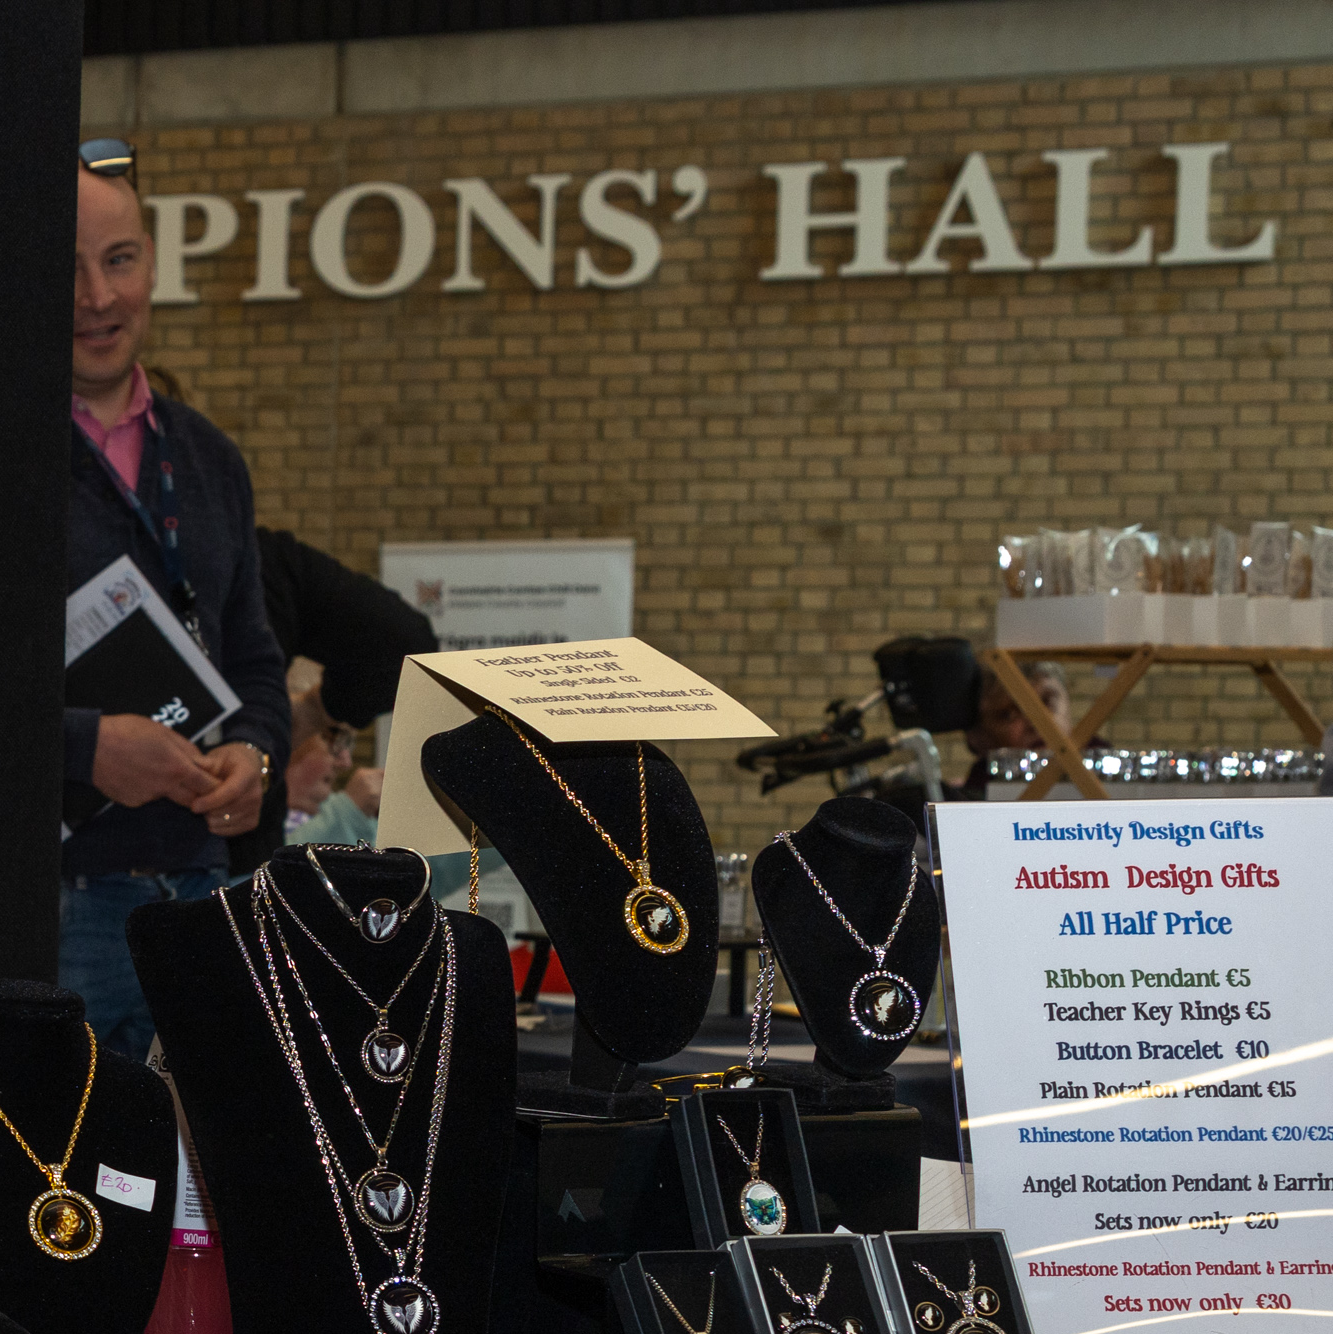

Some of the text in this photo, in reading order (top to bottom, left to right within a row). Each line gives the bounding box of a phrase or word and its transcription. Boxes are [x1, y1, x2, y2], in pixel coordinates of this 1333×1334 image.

[759, 140, 1278, 282] HALL
[475, 649, 619, 667] Feather Pendant
[504, 661, 624, 678] Up to 50% Off
[539, 679, 582, 687] Single
[579, 676, 617, 685] Sided
[509, 694, 586, 704] Rhinestone
[581, 691, 641, 700] Rotation
[636, 689, 692, 698] Pendant
[544, 708, 578, 716] Plain
[575, 706, 631, 715] Rotation
[627, 704, 678, 713] Pendant
[1012, 820, 1264, 847] Inclusivity Design Gifts
[1015, 863, 1280, 894] Autism Design Gifts
[1059, 910, 1233, 935] All Half Price
[1044, 968, 1251, 988] Ribbon Pendant €5
[1043, 1000, 1271, 1026] Teacher Key Rings €5
[1056, 1040, 1269, 1061] Button Bracelet €10
[1040, 1080, 1297, 1099] Plain Rotation Pendant €15
[1019, 1125, 1333, 1143] Rhinestone Rotation Pendant €20/€25
[1023, 1174, 1077, 1197] Angel
[1082, 1174, 1166, 1193] Rotation
[1172, 1174, 1251, 1193] Pendant
[1258, 1174, 1268, 1192] &
[1094, 1212, 1279, 1234] Sets now only €20
[183, 1233, 208, 1245] 900ml
[1028, 1259, 1333, 1277] Rhinestone Rotation Pendant & Earrin
[1104, 1293, 1291, 1314] Sets now only €30
